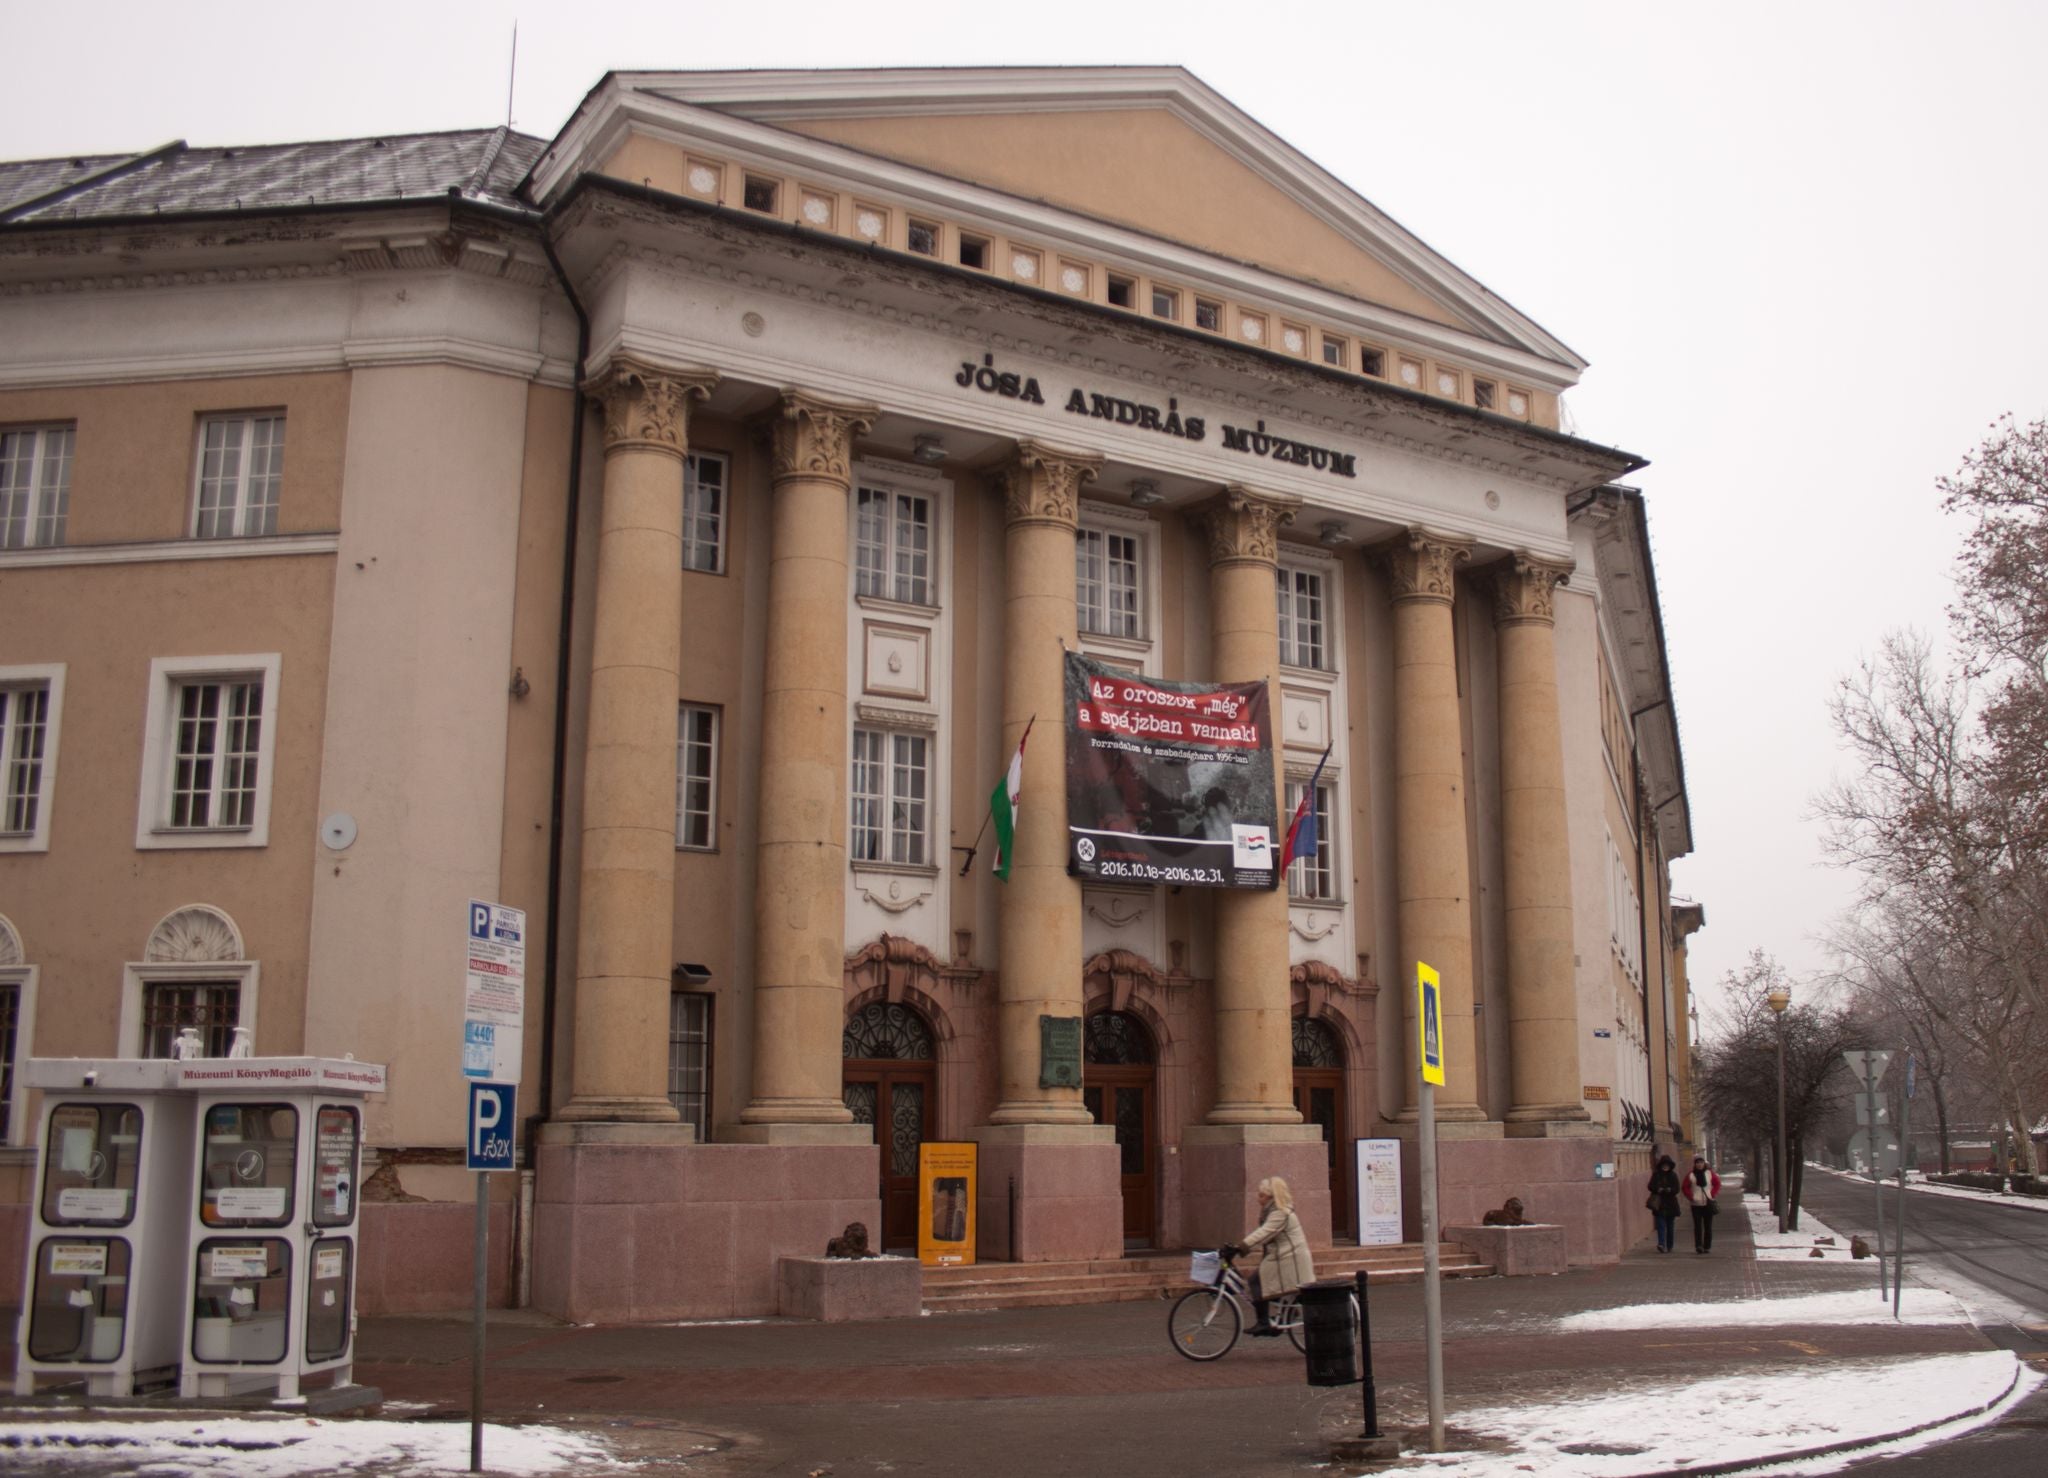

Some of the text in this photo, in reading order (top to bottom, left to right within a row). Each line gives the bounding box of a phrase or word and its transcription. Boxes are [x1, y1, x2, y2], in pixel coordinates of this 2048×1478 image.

[955, 354, 1357, 477] JÓSA ANDRÁS MÚZEUM
[1093, 681, 1114, 699] Az
[1123, 687, 1197, 709] oroszok
[1080, 708, 1257, 742] a spájzban vannak!
[1091, 739, 1249, 764] Forradalom és szabadságharc 1956-ban
[475, 907, 488, 934] P
[474, 1025, 495, 1041] 4401
[184, 1068, 312, 1081] Múzeumi KönyvMegálló
[474, 1089, 502, 1156] P
[497, 1139, 510, 1158] 2X
